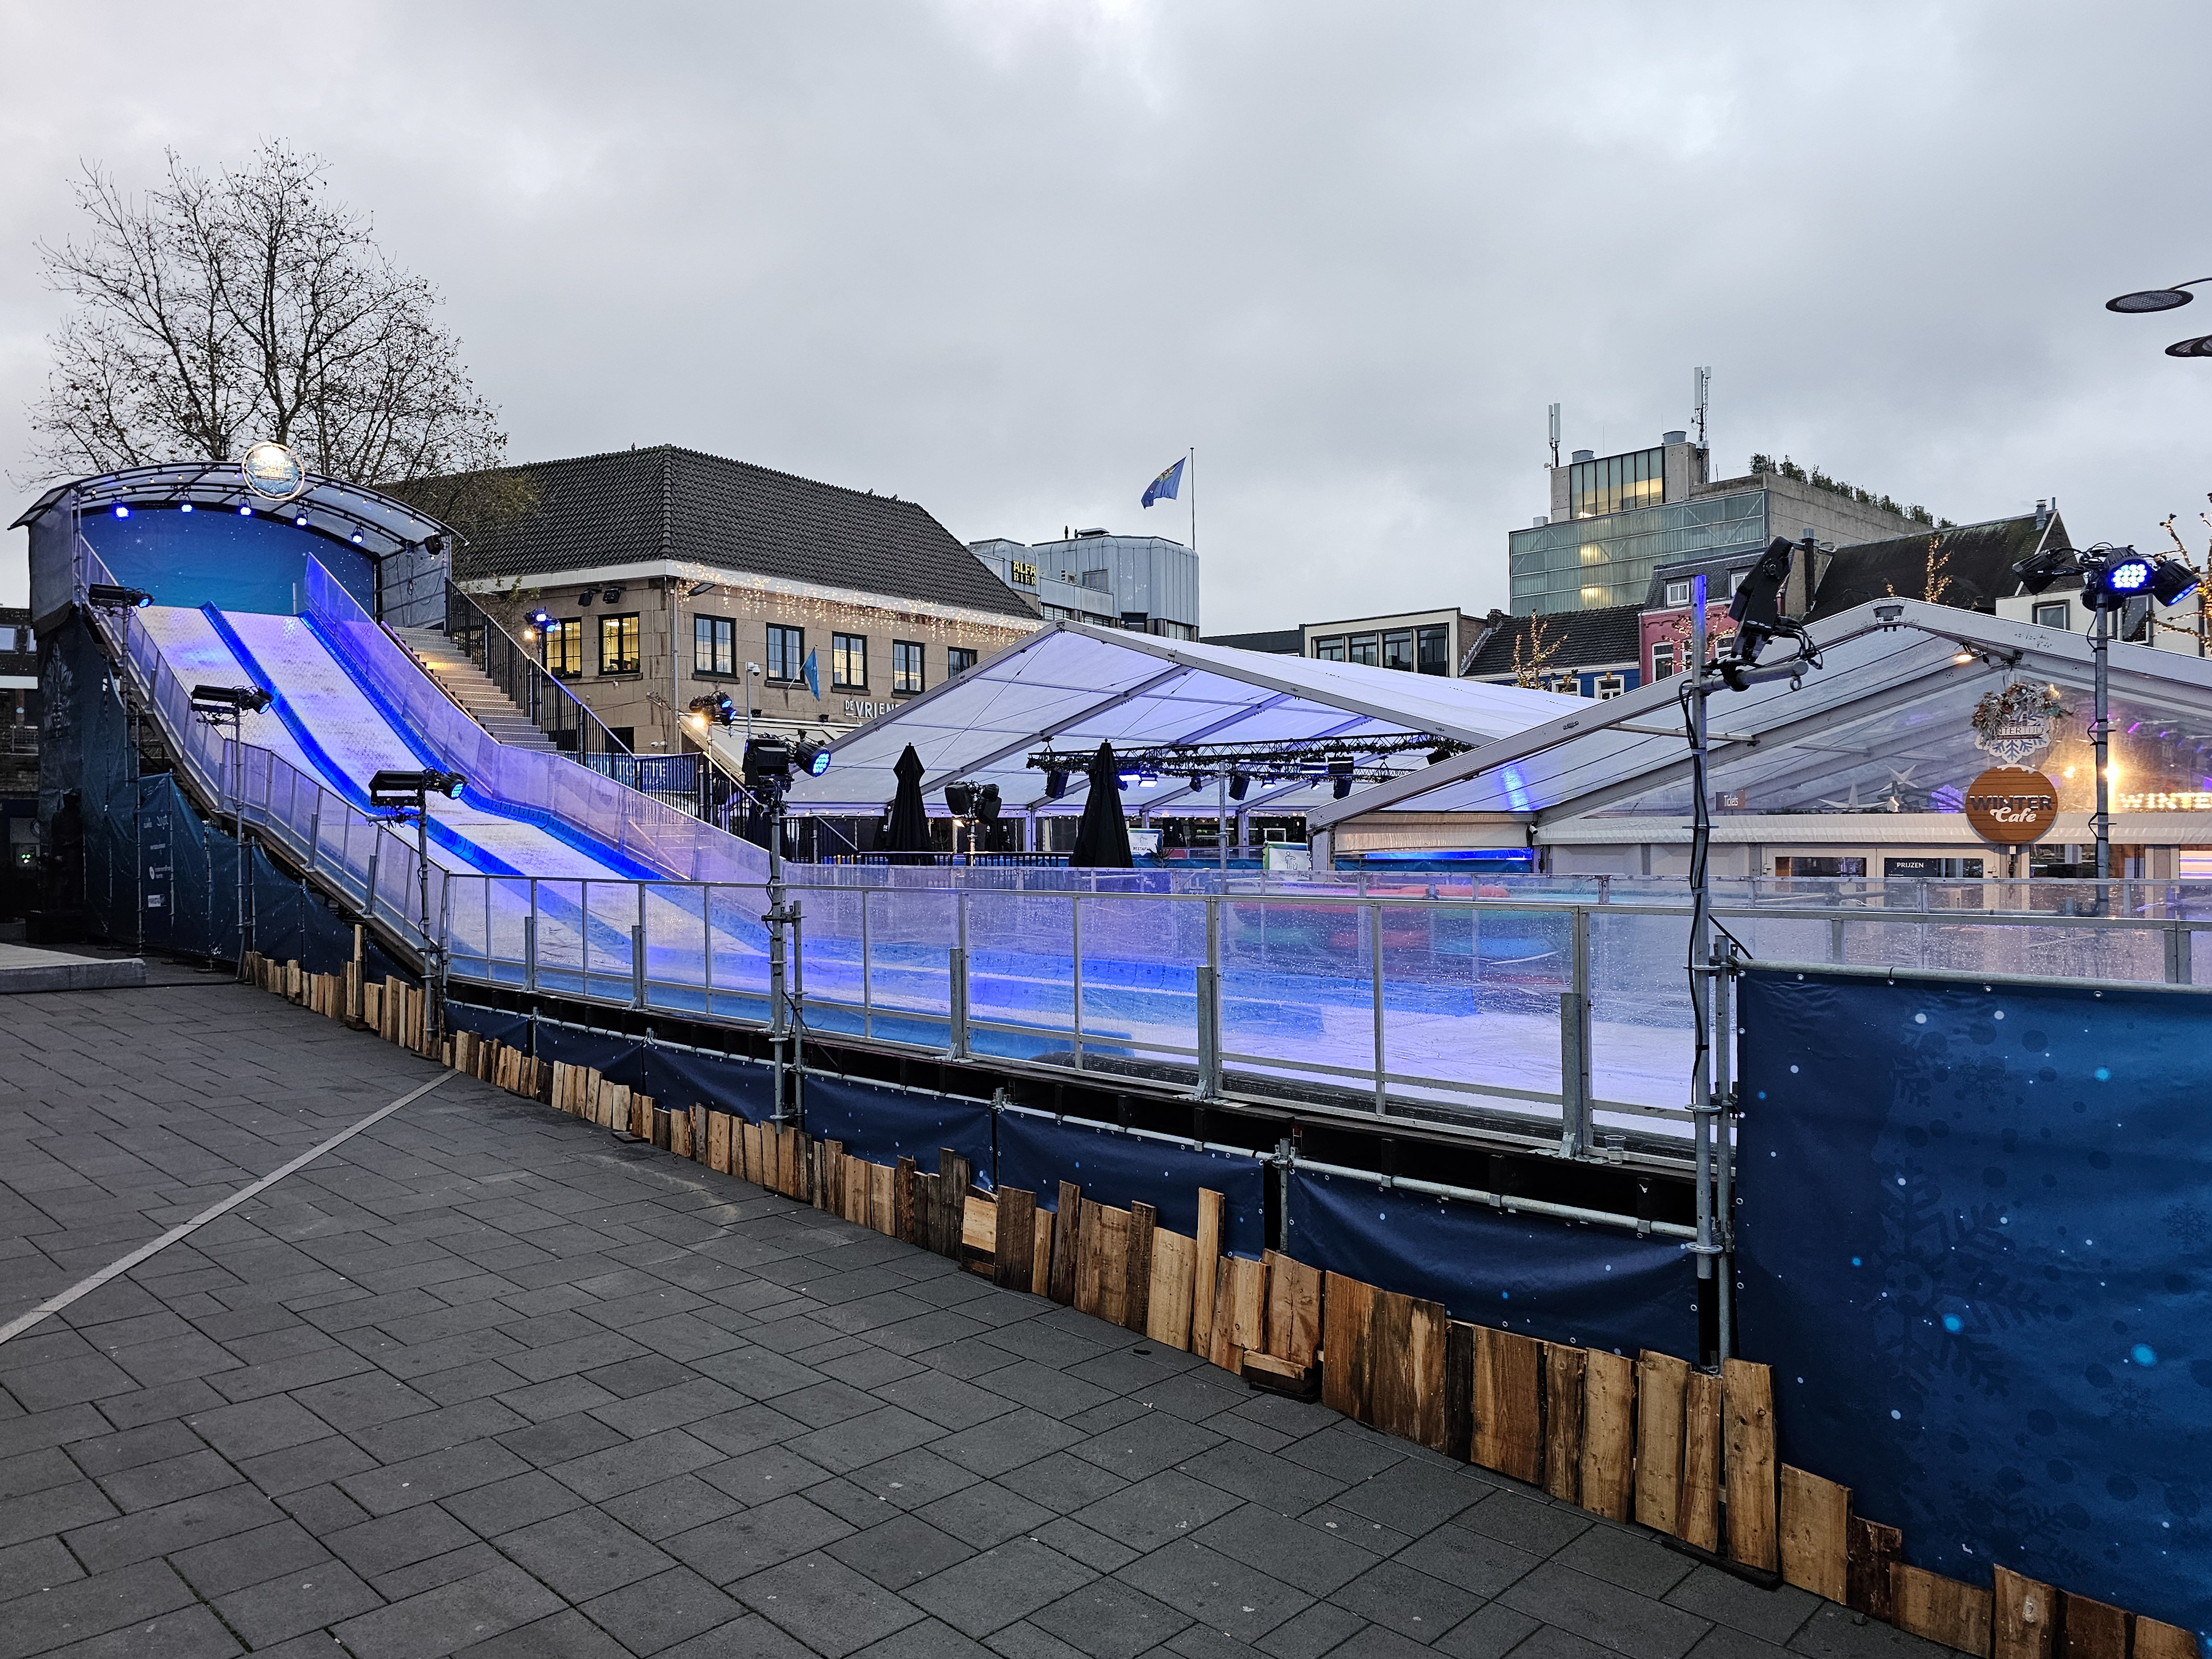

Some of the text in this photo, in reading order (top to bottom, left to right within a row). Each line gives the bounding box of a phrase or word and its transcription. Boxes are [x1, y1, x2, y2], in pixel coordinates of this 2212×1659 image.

[1013, 561, 1036, 577] ALFA
[1013, 572, 1036, 585] BIER
[845, 700, 854, 710] DE
[1998, 726, 2044, 734] NTERTIJD
[1969, 795, 2053, 811] WINTER
[2118, 793, 2212, 809] WINTE
[1990, 807, 2037, 822] Café
